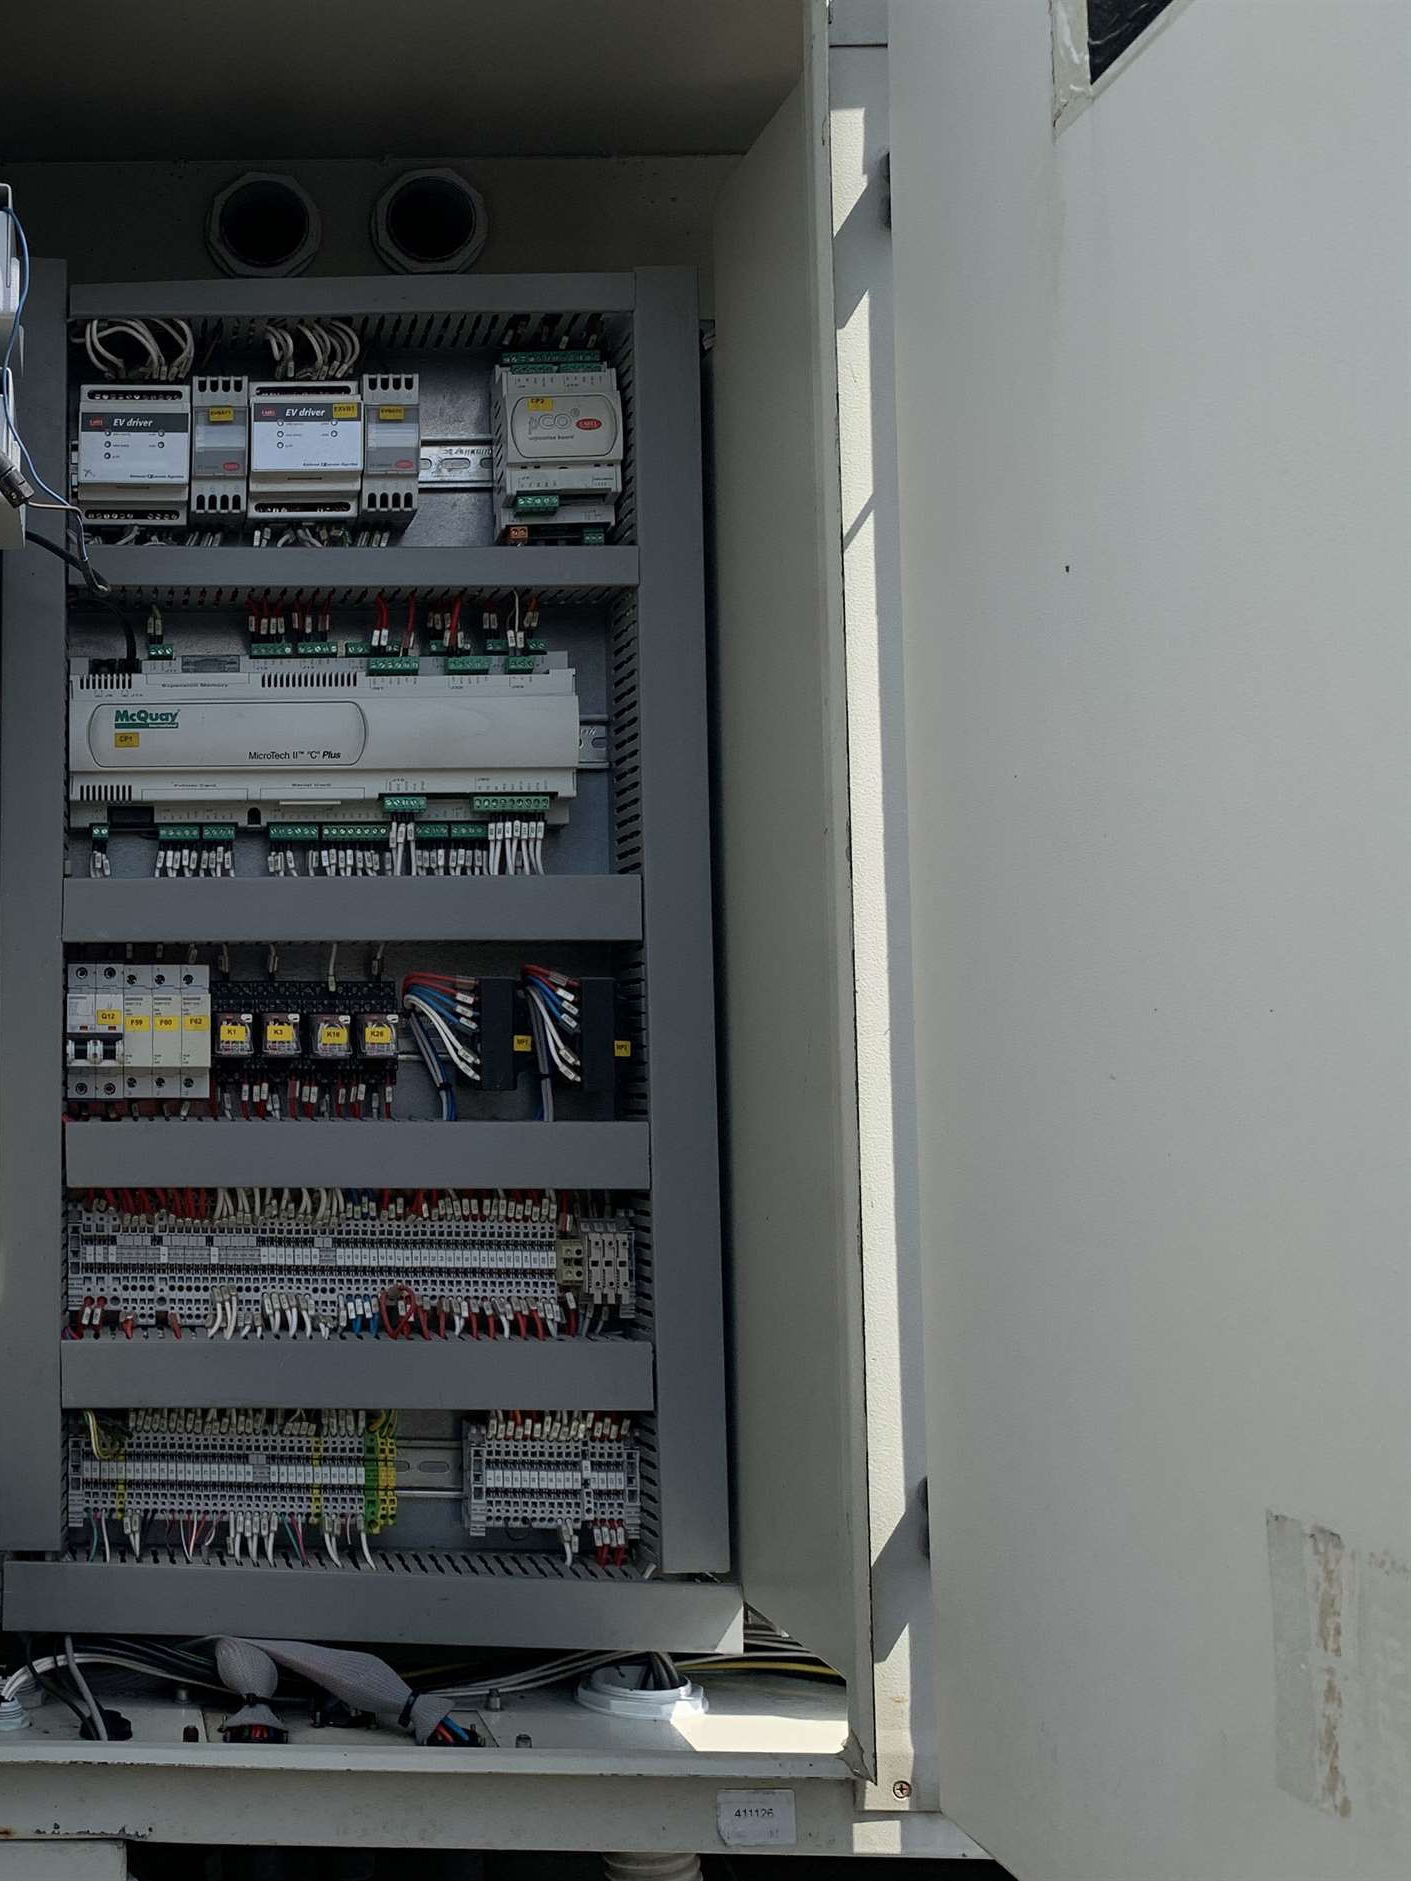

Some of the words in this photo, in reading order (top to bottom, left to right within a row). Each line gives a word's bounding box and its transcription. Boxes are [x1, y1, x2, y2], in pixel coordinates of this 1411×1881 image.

[285, 408, 298, 417] EV
[299, 407, 326, 417] driver
[113, 418, 126, 427] EV
[127, 418, 153, 427] driver
[114, 709, 179, 723] McQuay
[119, 735, 133, 743] CP1
[248, 751, 290, 760] MicroTech
[322, 750, 341, 760] Plus
[101, 1013, 115, 1021] Q12
[734, 1808, 774, 1818] 411126
